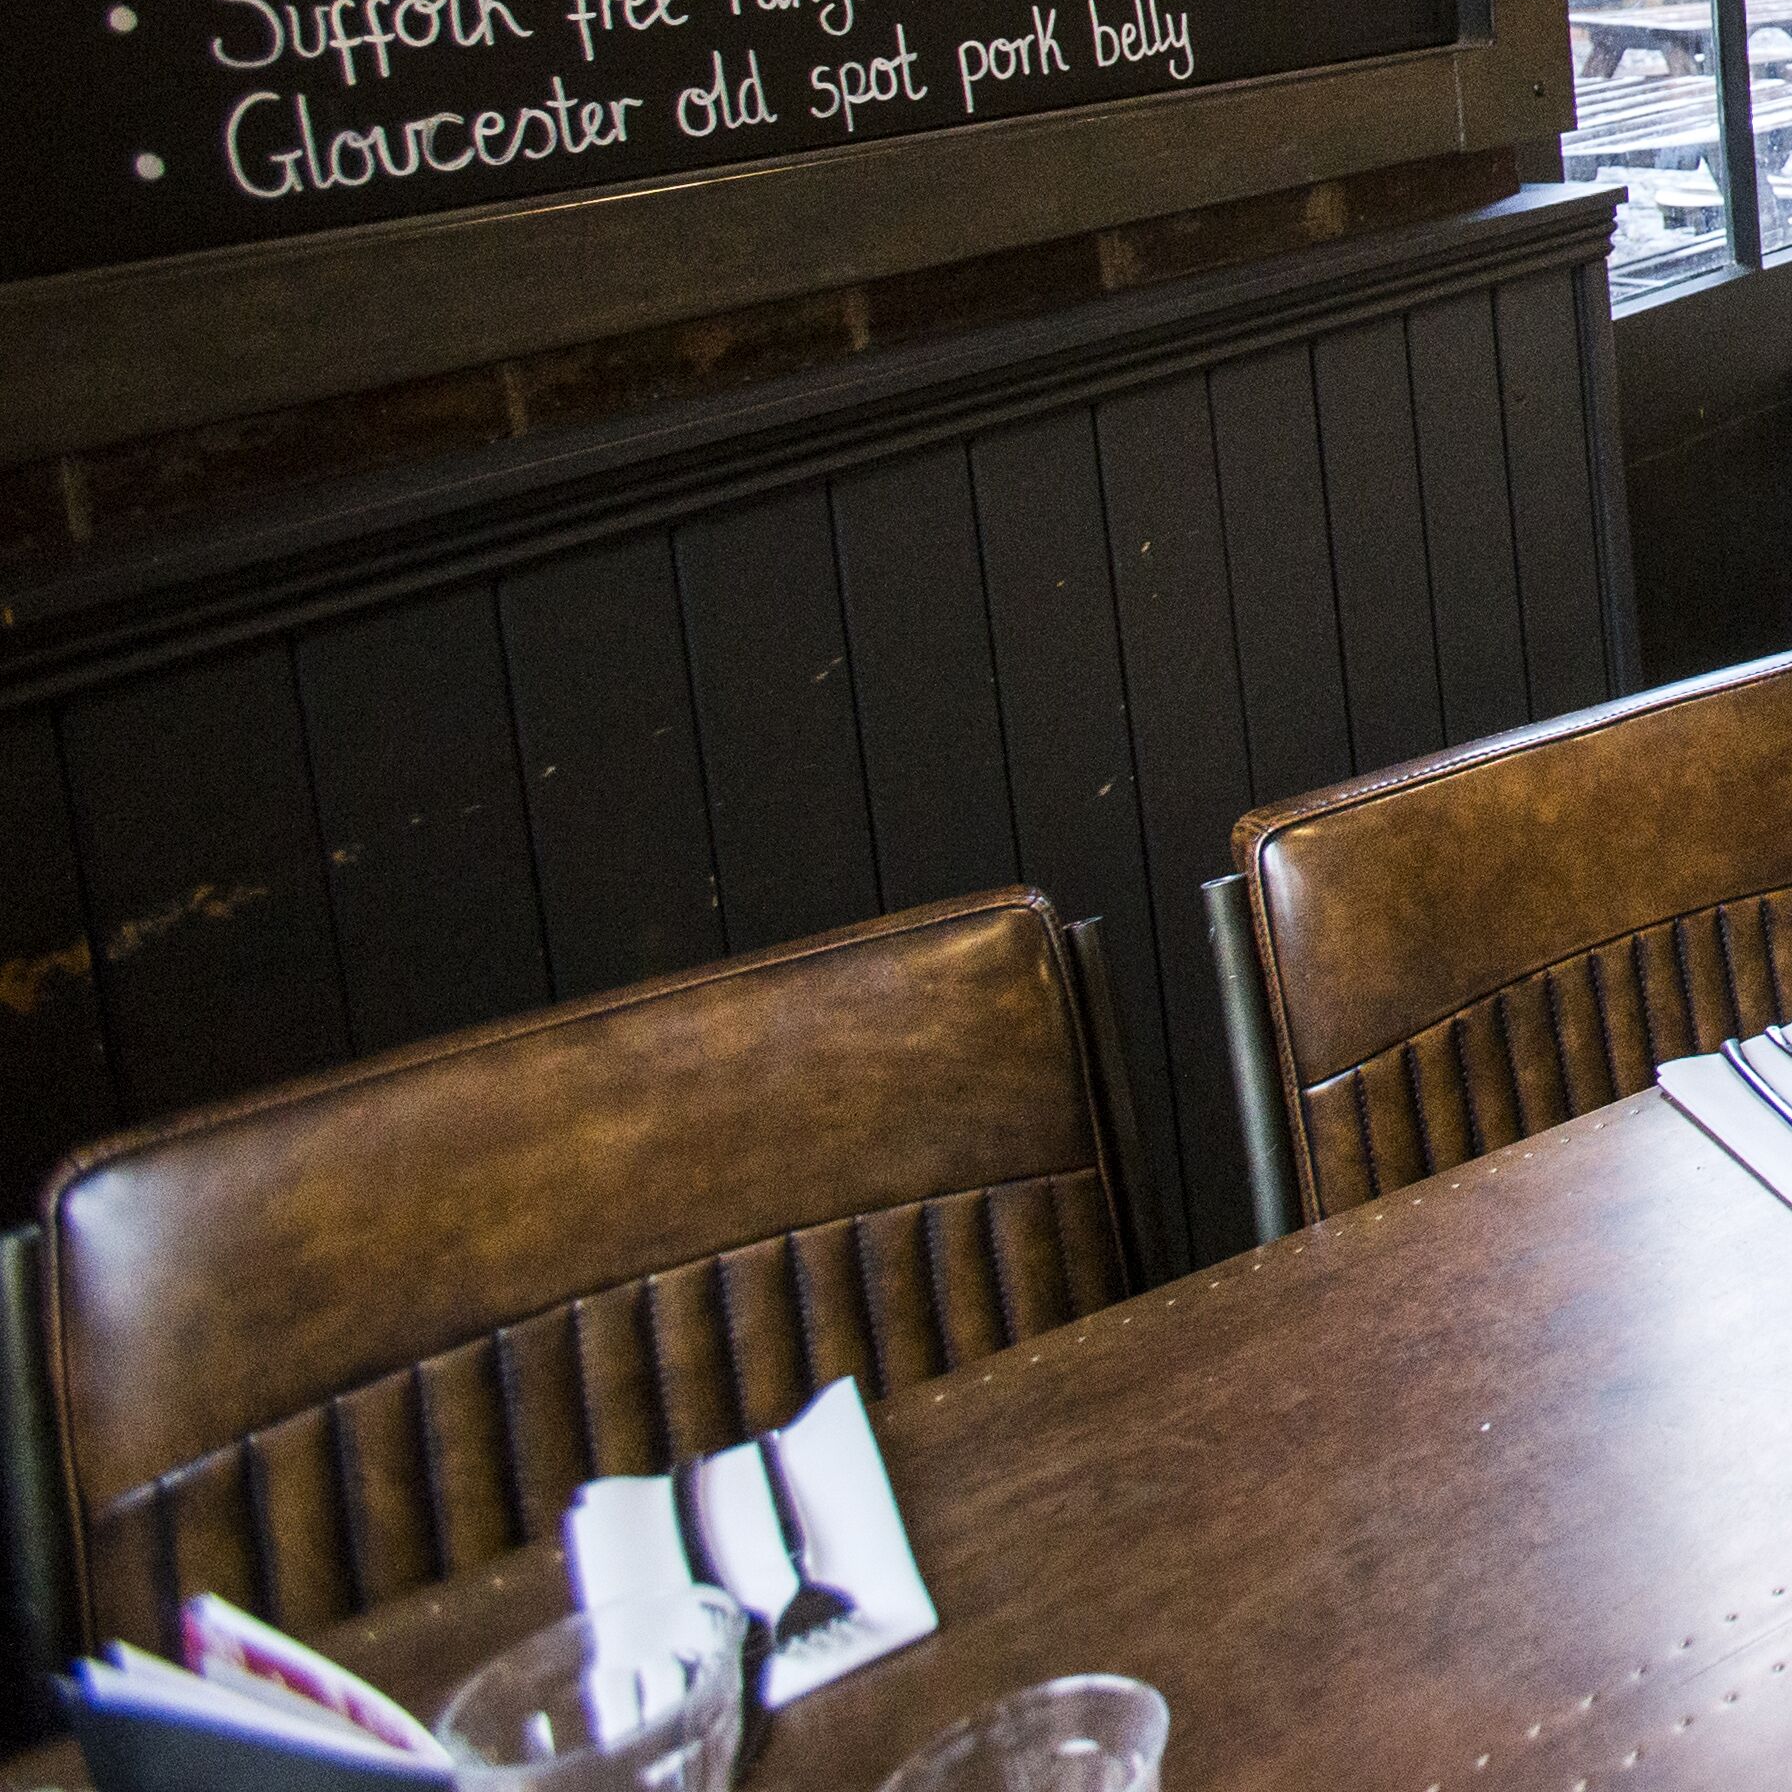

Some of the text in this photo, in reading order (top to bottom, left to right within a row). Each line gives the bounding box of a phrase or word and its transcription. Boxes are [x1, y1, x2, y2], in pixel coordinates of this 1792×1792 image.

[225, 75, 644, 199] Gloucester
[676, 49, 778, 137] old
[809, 22, 928, 132] spot
[957, 5, 1070, 114] pork
